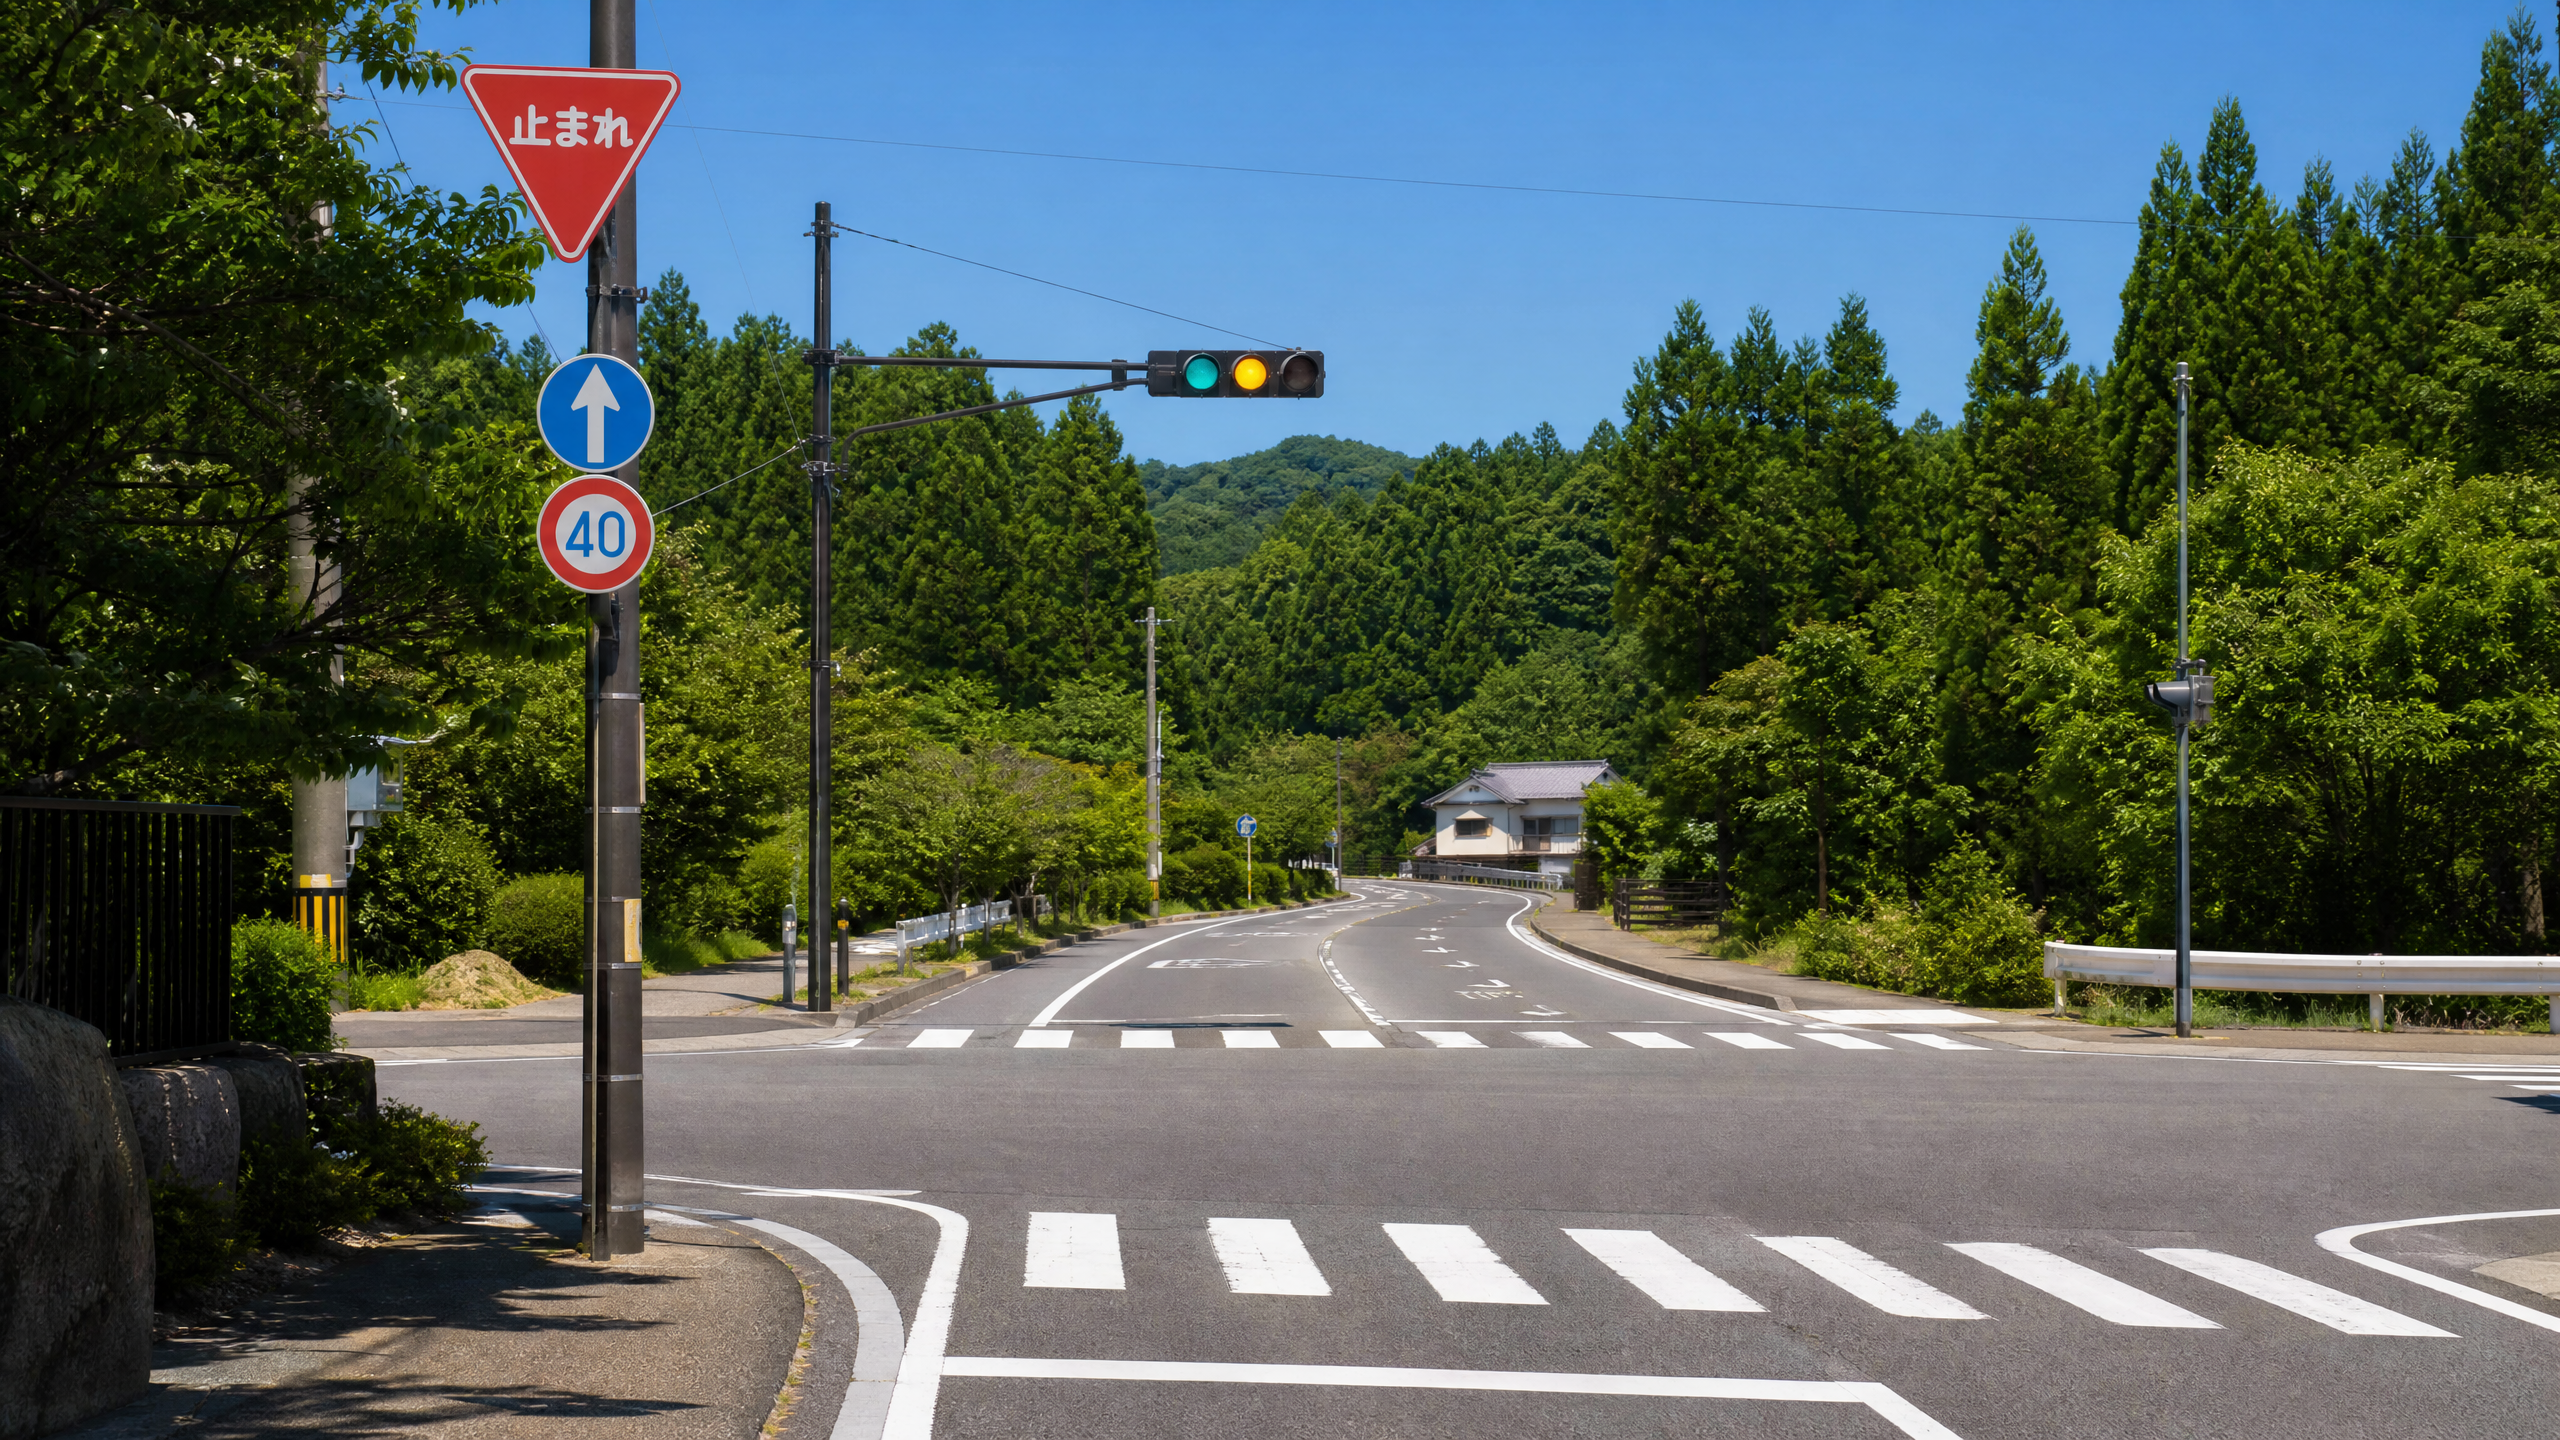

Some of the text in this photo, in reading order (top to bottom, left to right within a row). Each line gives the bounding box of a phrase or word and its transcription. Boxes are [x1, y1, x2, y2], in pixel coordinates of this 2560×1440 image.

[508, 104, 634, 149] 止まれ
[565, 510, 626, 558] 40
